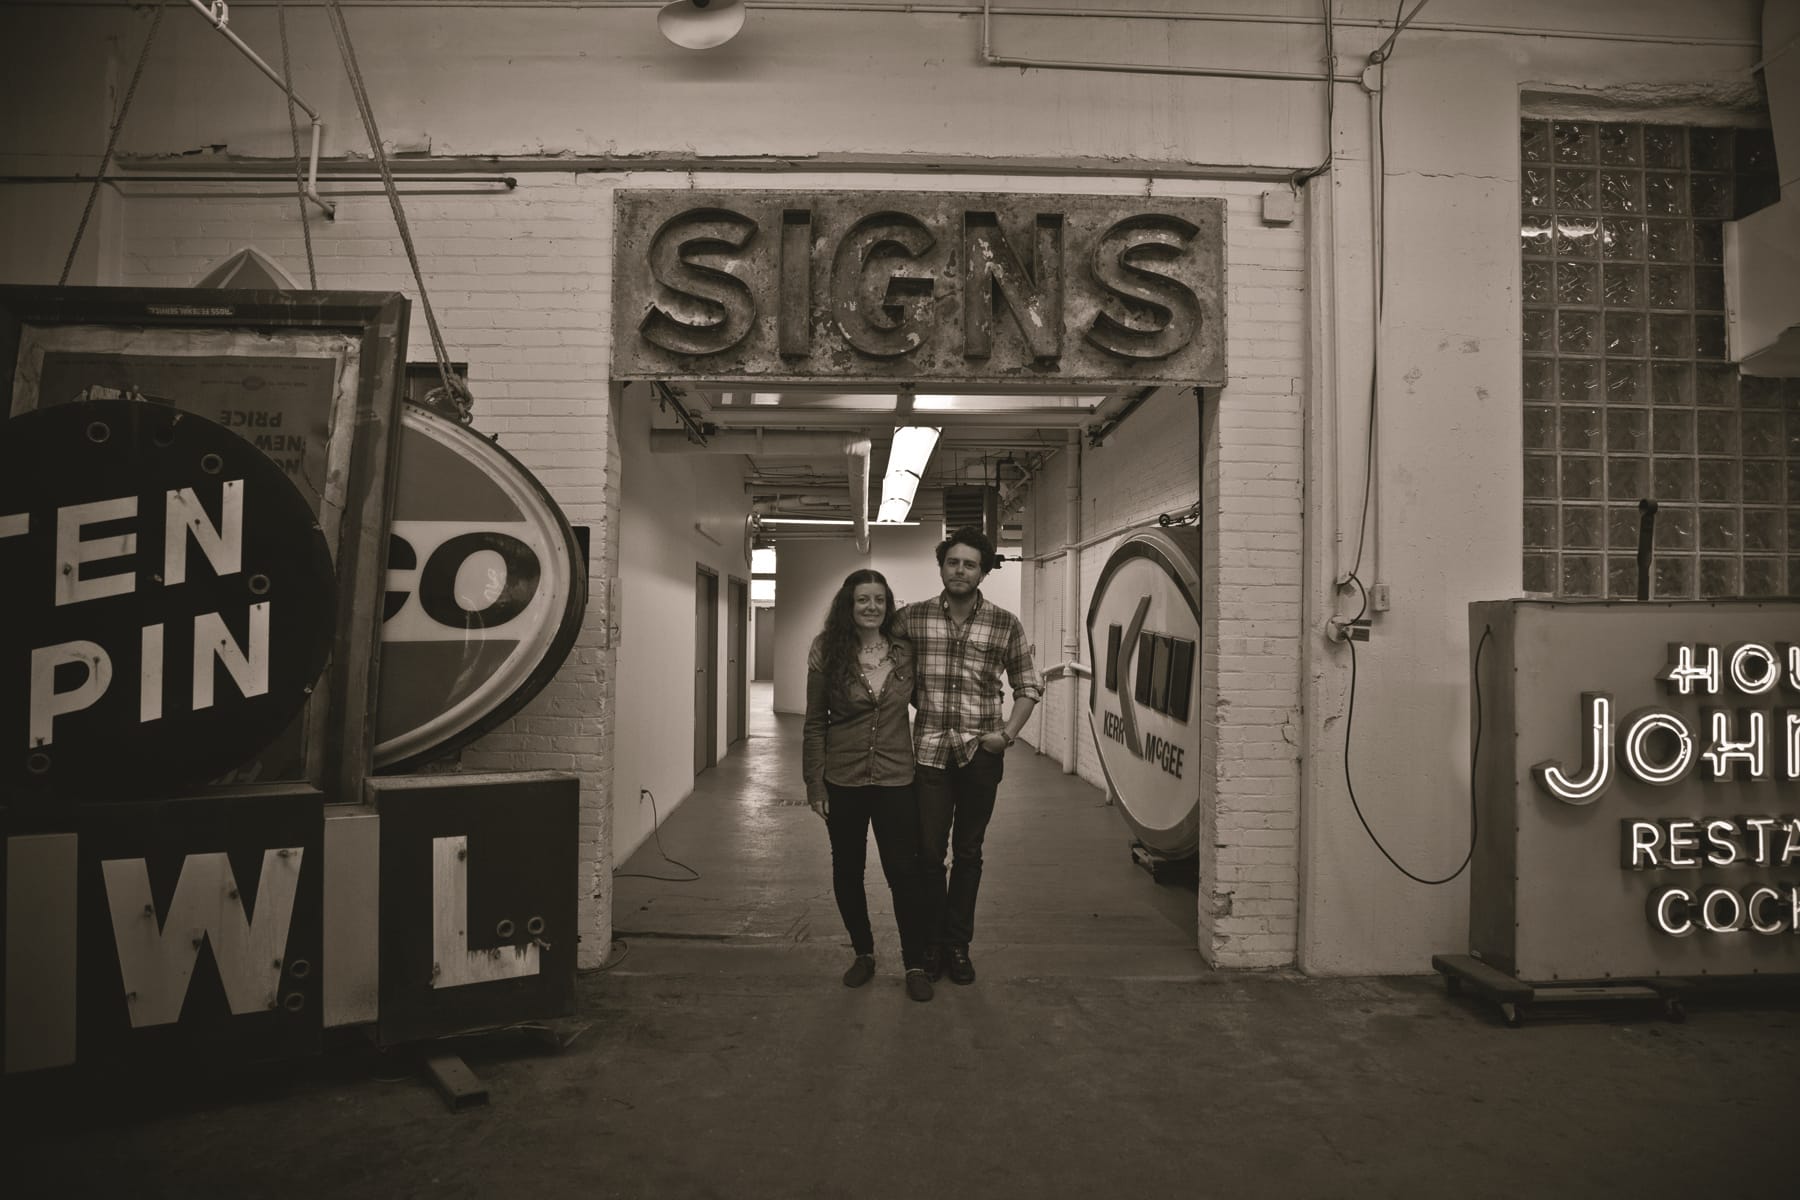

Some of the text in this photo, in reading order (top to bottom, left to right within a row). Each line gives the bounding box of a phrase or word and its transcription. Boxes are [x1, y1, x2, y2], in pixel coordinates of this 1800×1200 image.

[638, 207, 1202, 360] SIGNS
[220, 410, 282, 427] PRICE
[256, 435, 301, 451] NEW
[29, 601, 270, 749] PIN
[1103, 709, 1124, 745] KERR
